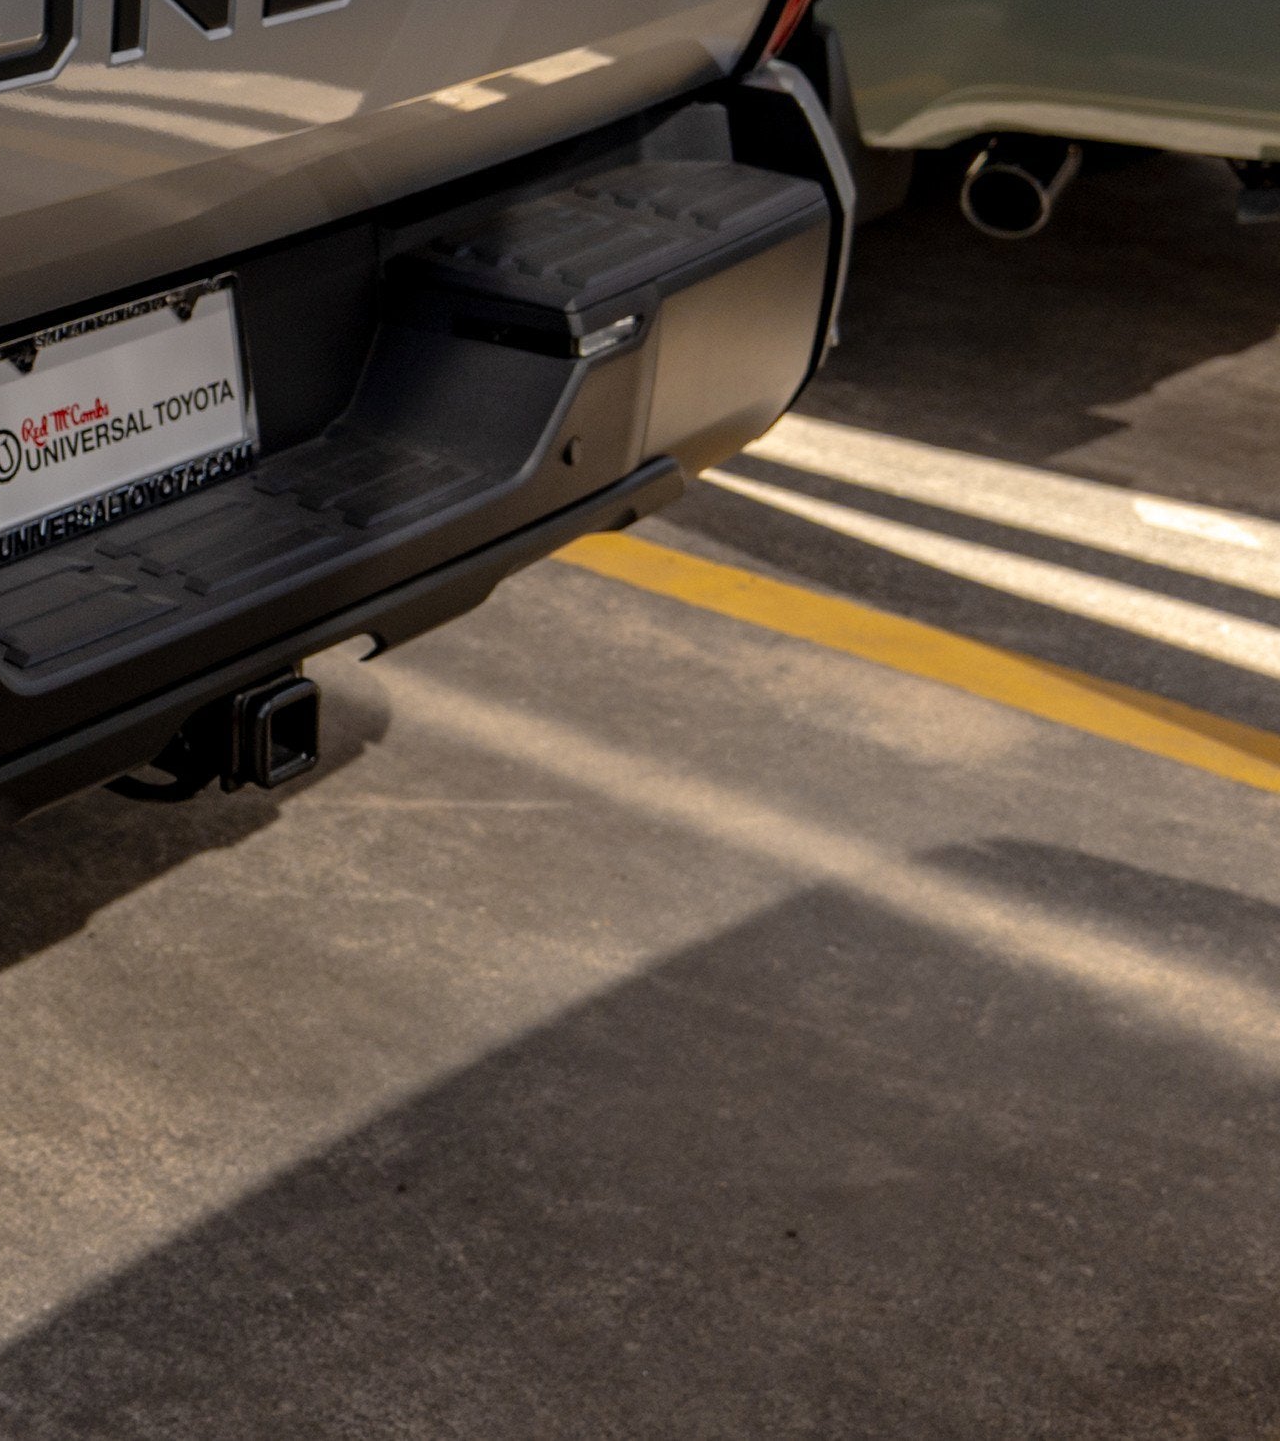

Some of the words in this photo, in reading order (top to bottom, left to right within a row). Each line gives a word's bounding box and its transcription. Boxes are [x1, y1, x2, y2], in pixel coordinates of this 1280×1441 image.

[22, 415, 48, 447] Red
[25, 409, 153, 472] UNIVERSAL
[153, 379, 235, 429] TOYOTA
